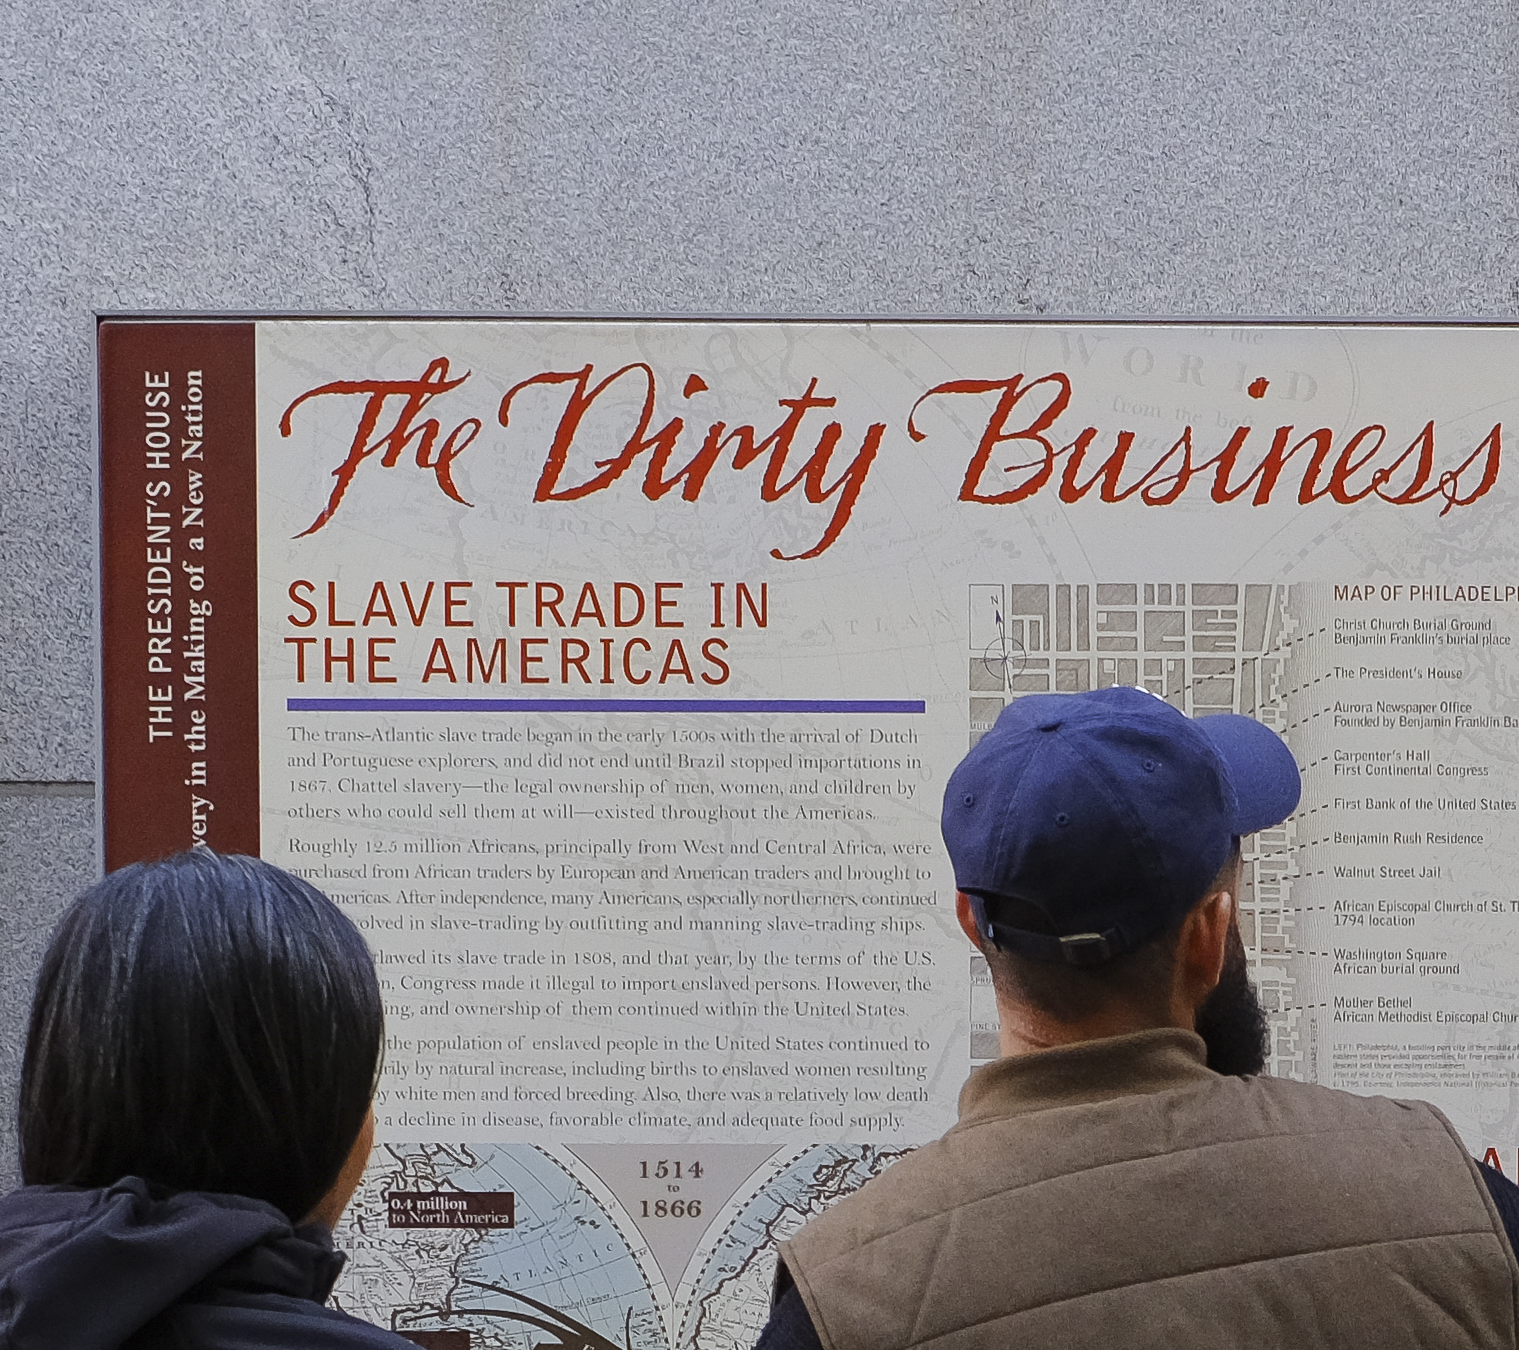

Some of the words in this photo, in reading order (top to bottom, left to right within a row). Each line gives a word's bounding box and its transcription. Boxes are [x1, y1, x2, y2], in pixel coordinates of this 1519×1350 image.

[144, 370, 171, 469] HOUSE
[180, 369, 204, 462] Nation
[279, 356, 475, 539] The
[499, 362, 887, 561] Dirty
[908, 372, 1503, 518] Business
[181, 468, 204, 529] New
[188, 536, 205, 551] a
[145, 480, 173, 673] PRESIDENT'S
[181, 560, 205, 592] of
[287, 579, 475, 629] SLAVE
[496, 581, 685, 629] TRADE
[711, 582, 769, 629] IN
[1334, 584, 1376, 602] MAP
[1380, 584, 1404, 603] OF
[1334, 617, 1366, 632] Christ
[1370, 617, 1410, 632] Church
[1413, 617, 1447, 632] Burial
[1450, 617, 1492, 632] Ground
[182, 598, 213, 702] Making
[285, 636, 399, 684] THE
[421, 635, 731, 685] AMERICAS
[1333, 666, 1355, 680] The
[1359, 665, 1423, 679] President's
[1427, 666, 1463, 680] House
[147, 684, 173, 744] THE
[183, 709, 207, 753] the
[286, 726, 320, 742] The
[324, 726, 435, 743] trans-Atlantic
[438, 726, 477, 743] slave
[481, 726, 523, 743] trade
[526, 726, 573, 747] began
[578, 727, 593, 743] in
[597, 726, 623, 743] the
[626, 727, 666, 747] early
[672, 730, 716, 744] 1500s
[720, 726, 756, 743] with
[760, 727, 786, 744] the
[789, 727, 840, 744] arrival
[845, 728, 863, 744] of
[870, 728, 918, 744] Dutch
[184, 761, 207, 787] in
[1334, 797, 1361, 810] First
[1365, 797, 1396, 810] Bank
[1399, 797, 1411, 810] of
[1415, 797, 1434, 810] the
[1437, 797, 1476, 811] United
[1480, 797, 1517, 811] States
[191, 793, 215, 848] very
[1333, 947, 1402, 963] Washington
[1405, 947, 1448, 963] Square
[639, 1159, 704, 1180] 1514
[666, 1184, 680, 1193] to
[390, 1198, 413, 1211] 0.4
[416, 1196, 468, 1211] million
[639, 1199, 702, 1219] 1866
[392, 1212, 406, 1224] to
[409, 1210, 450, 1224] North
[454, 1210, 510, 1224] America
